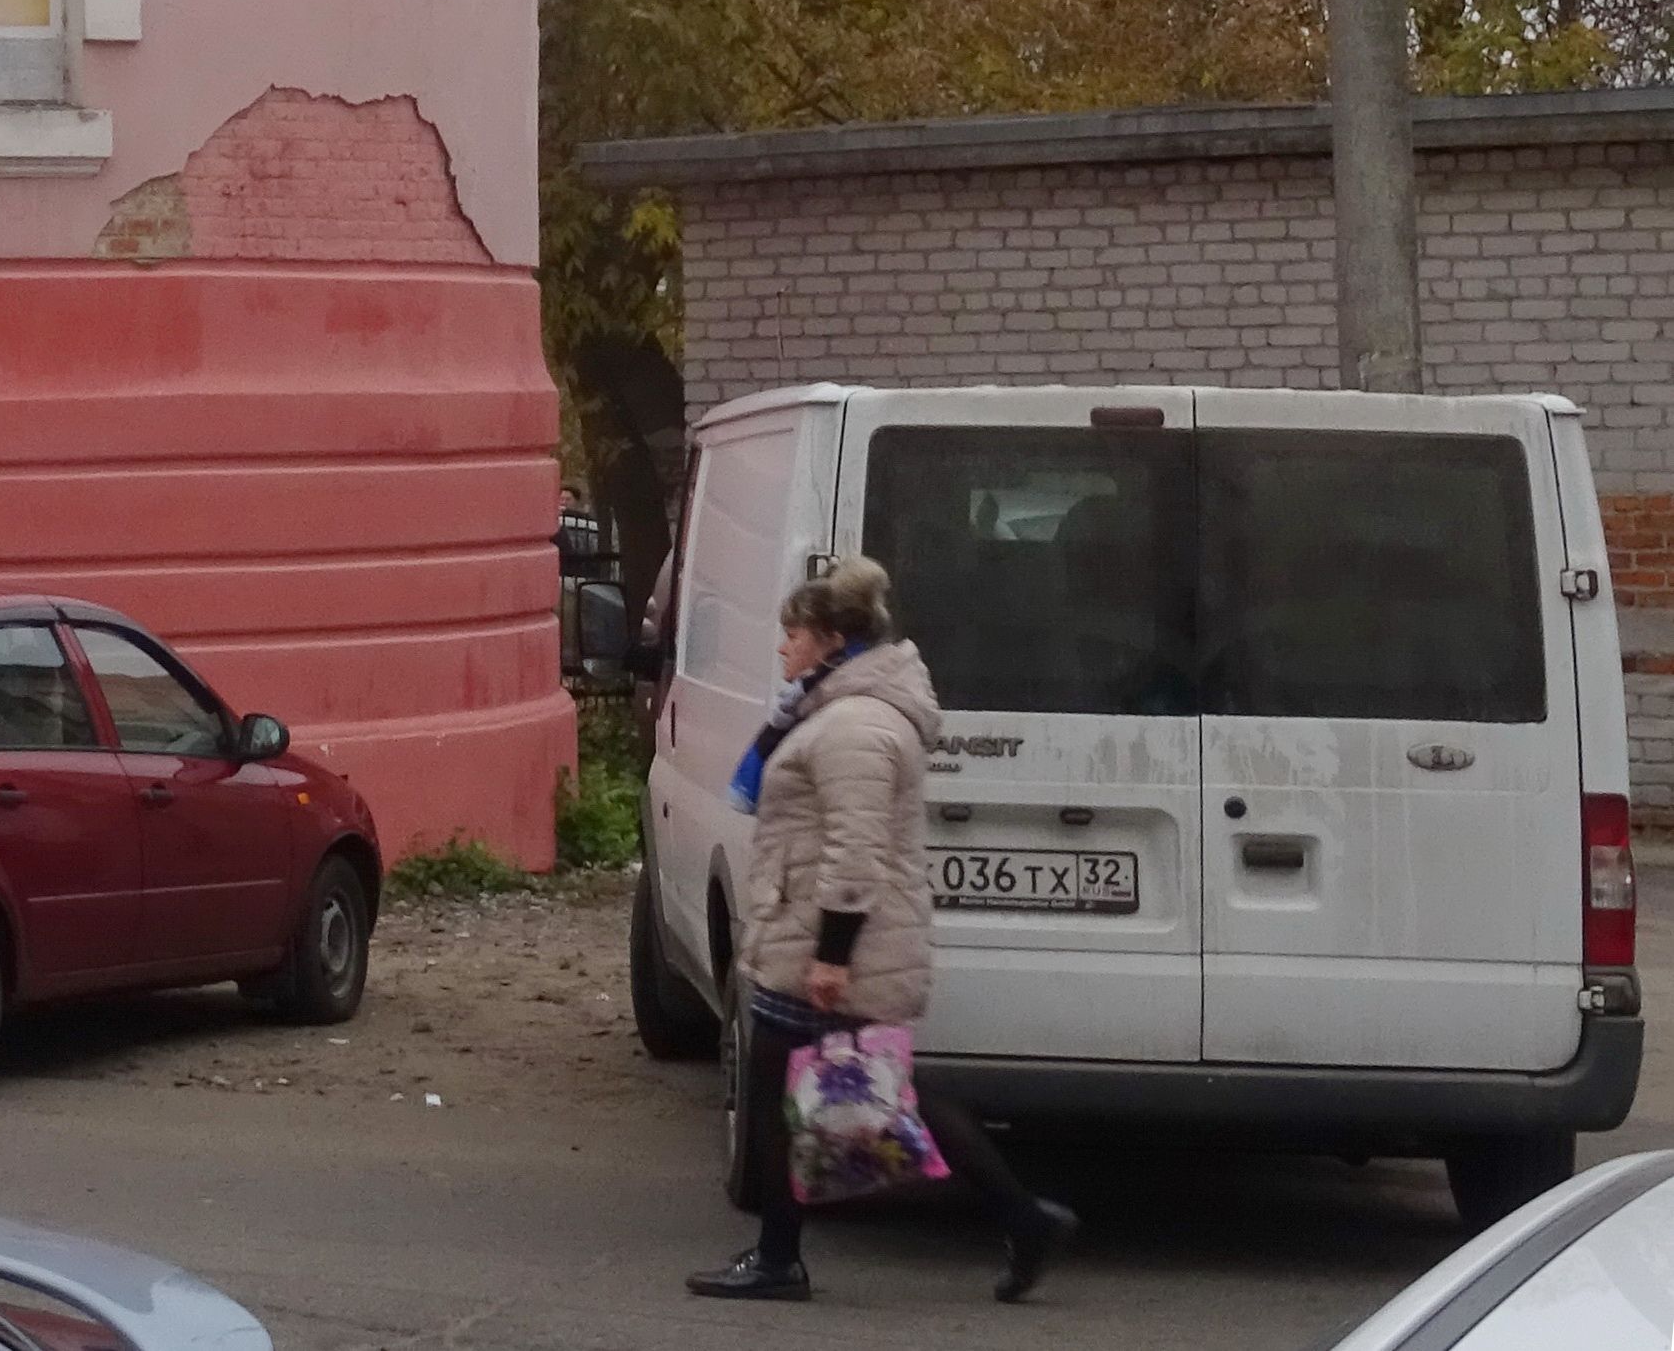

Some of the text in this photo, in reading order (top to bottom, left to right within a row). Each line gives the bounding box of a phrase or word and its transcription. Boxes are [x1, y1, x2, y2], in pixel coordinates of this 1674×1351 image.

[930, 737, 1023, 757] ANSIT
[927, 855, 1121, 896] 036ТХ 32
